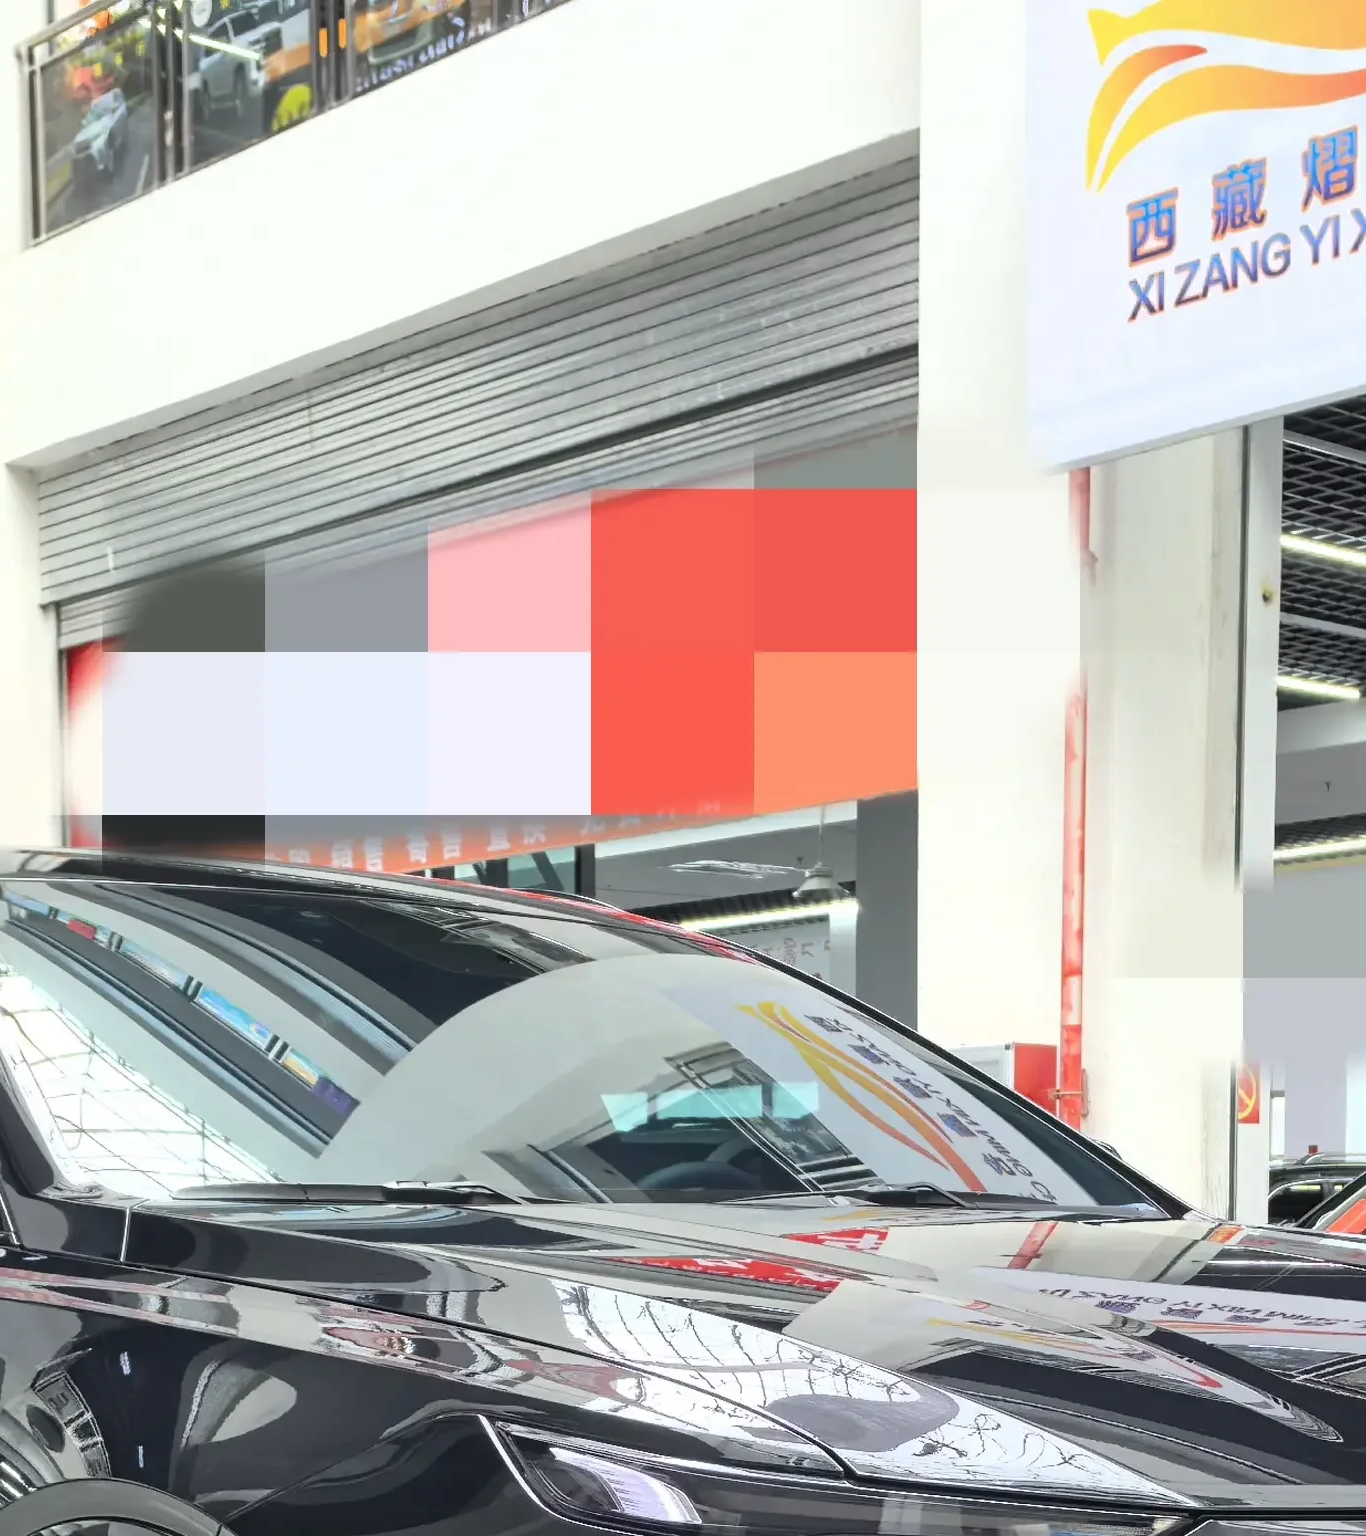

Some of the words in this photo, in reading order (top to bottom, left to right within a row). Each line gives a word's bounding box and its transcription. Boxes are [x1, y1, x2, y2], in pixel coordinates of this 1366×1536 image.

[1127, 270, 1166, 323] XI
[1173, 231, 1292, 308] ZANG
[1299, 213, 1341, 265] YI
